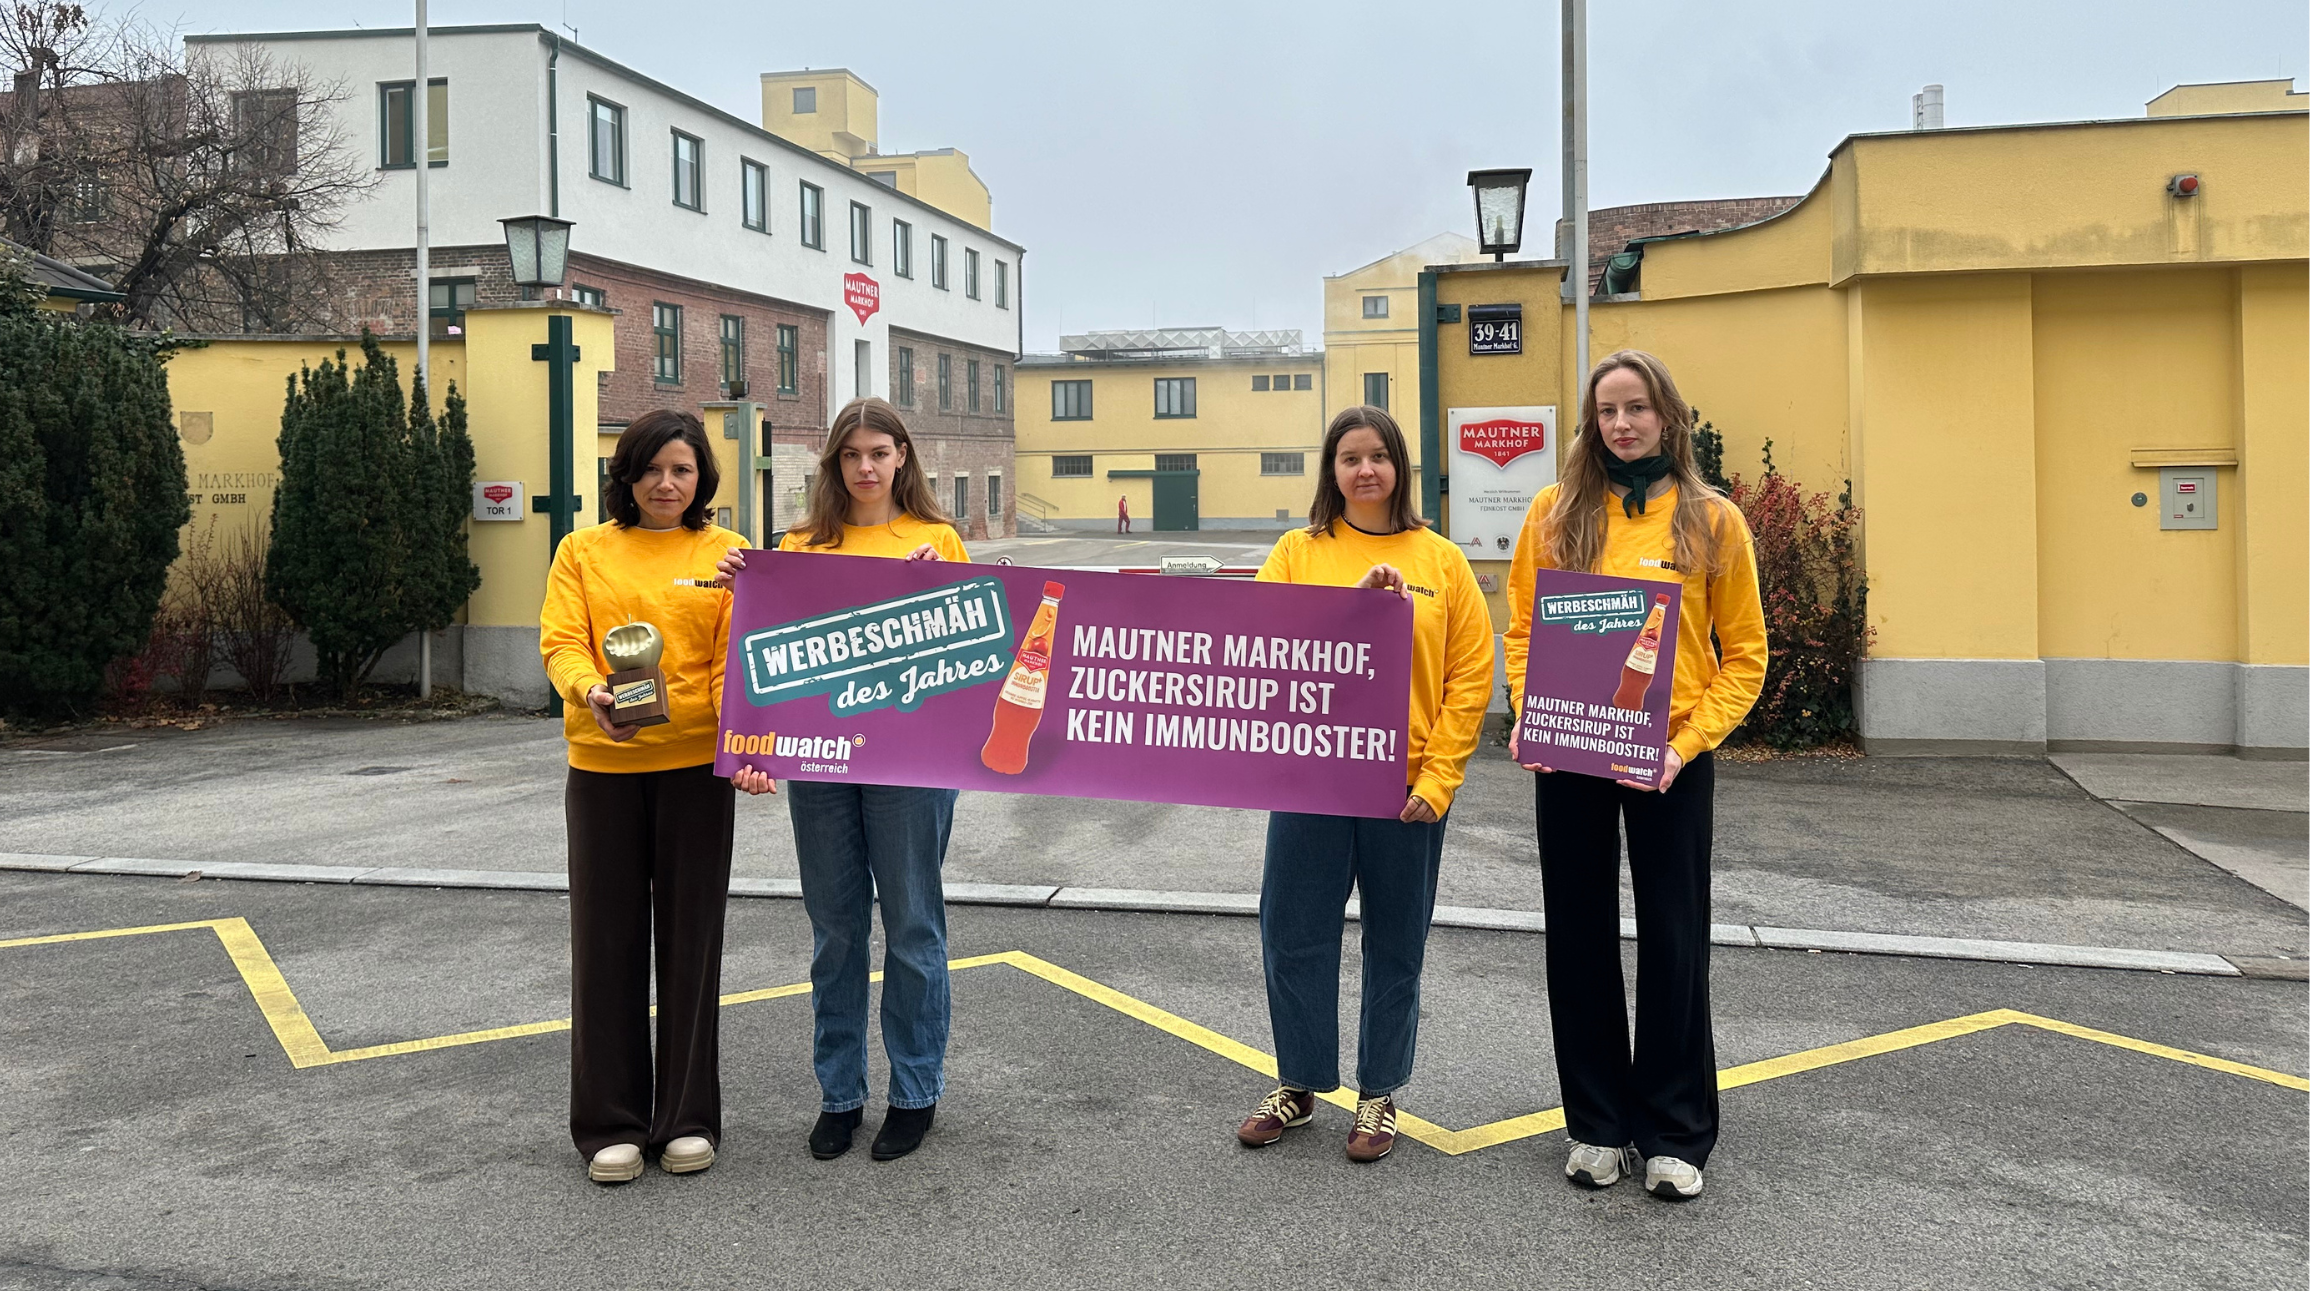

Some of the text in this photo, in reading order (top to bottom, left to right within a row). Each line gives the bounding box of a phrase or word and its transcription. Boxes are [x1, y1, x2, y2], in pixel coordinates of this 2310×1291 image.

[845, 277, 878, 298] MAUTNER
[1474, 322, 1518, 342] 39-41
[1463, 427, 1540, 438] MAUTNER
[1474, 439, 1529, 448] MARKHOF
[198, 473, 275, 489] MARKHOF
[212, 493, 246, 504] GMBH
[486, 507, 511, 515] TOR 1
[1405, 584, 1434, 598] watch
[1547, 594, 1638, 614] WERBESCHMÄH
[761, 594, 988, 677] WERBESCHMÄH
[1574, 617, 1643, 634] des Jahres
[1072, 625, 1375, 681] MAUTNER MARKHOF,
[836, 653, 1004, 710] des Jahres
[1068, 666, 1335, 715] ZUCKERSIRUP IST
[1526, 694, 1652, 728] MAUTNER MARKHOF,
[1066, 708, 1397, 762] KEIN IMMUNBOOSTER!
[1525, 711, 1635, 741] ZUCKERSIRUP IST
[723, 730, 851, 760] foodwatch
[1523, 727, 1659, 762] KEIN IMMUNBOOSTER!
[801, 761, 848, 773] österreich
[1611, 763, 1653, 777] foodwatch
